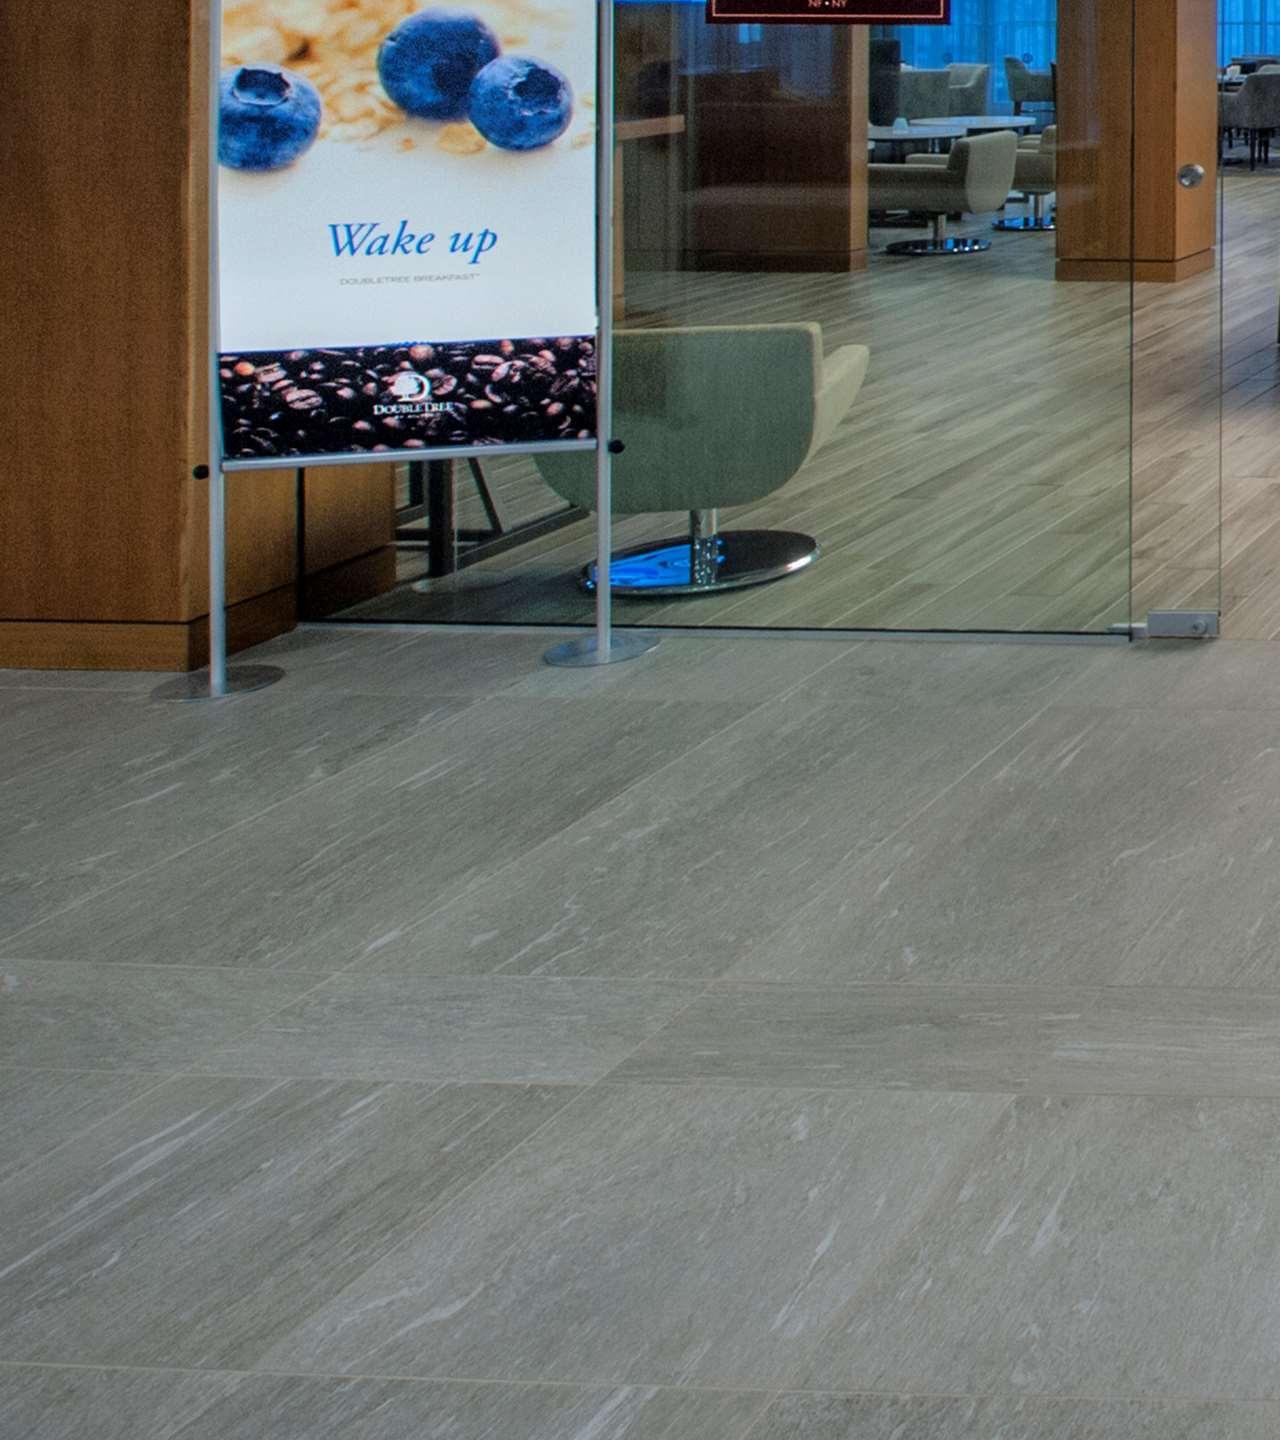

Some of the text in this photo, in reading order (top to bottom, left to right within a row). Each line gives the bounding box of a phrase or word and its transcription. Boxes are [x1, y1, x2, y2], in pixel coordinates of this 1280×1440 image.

[327, 219, 499, 265] Wake up
[339, 275, 410, 286] DOUBLETREE
